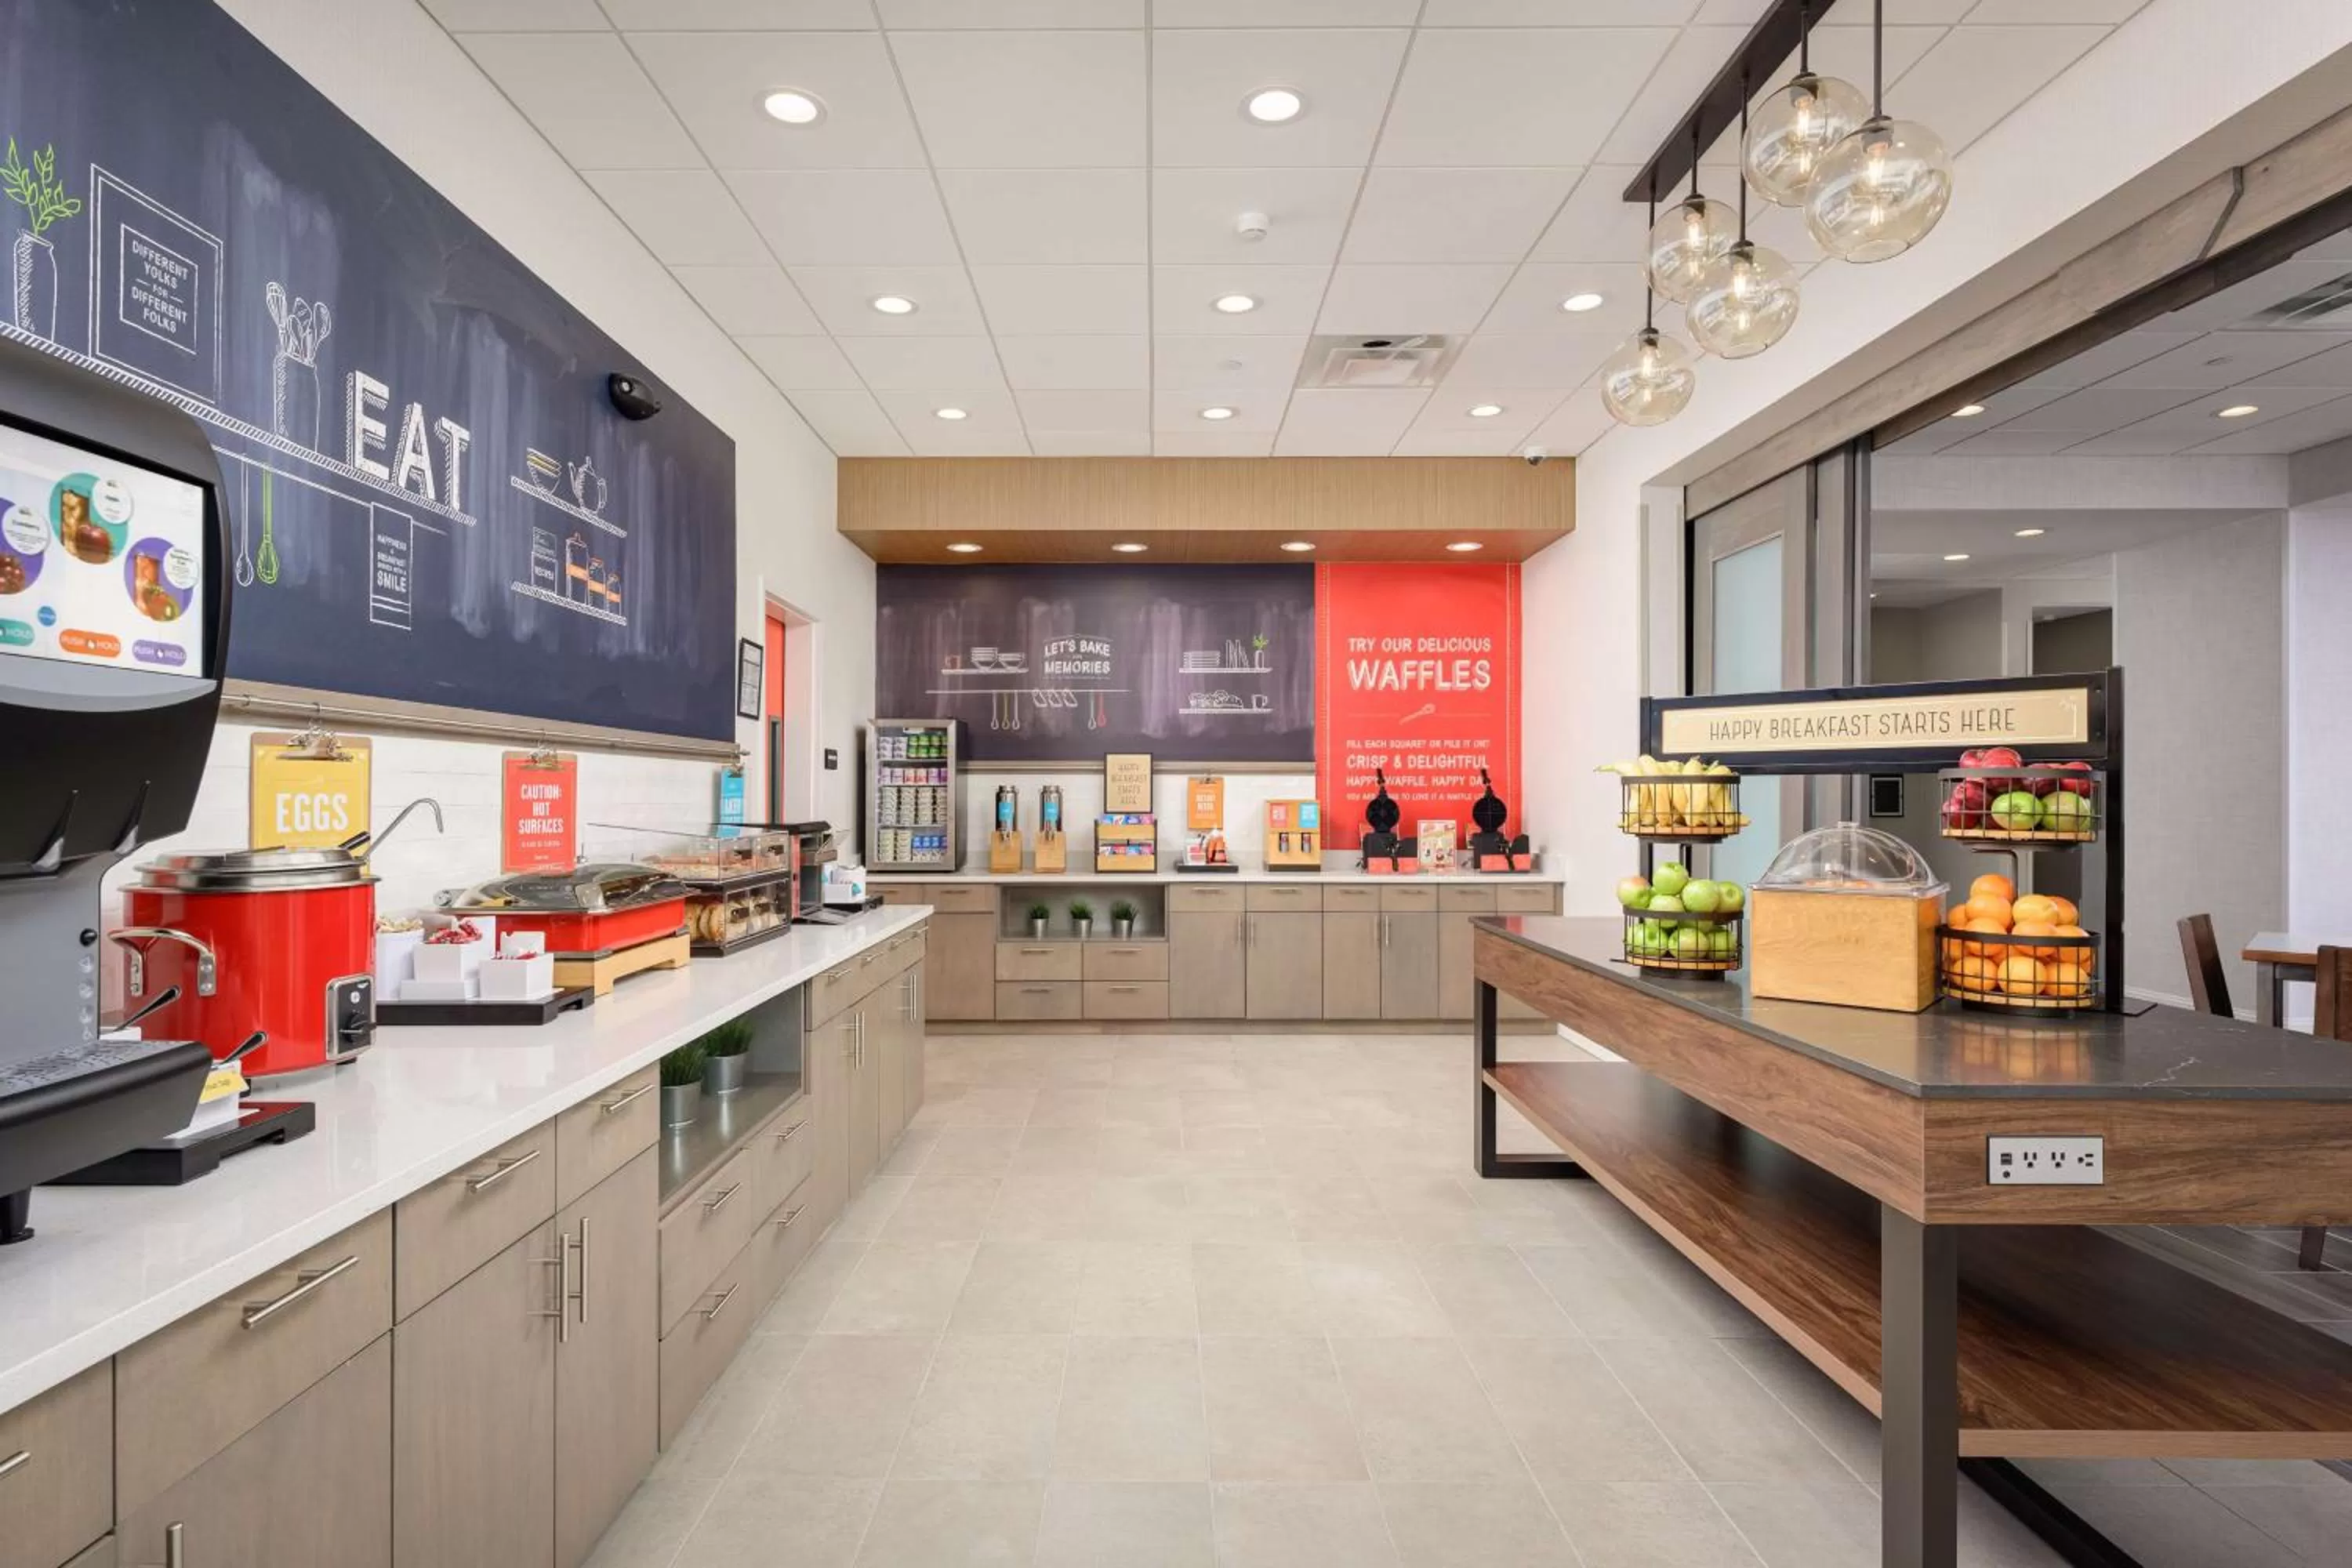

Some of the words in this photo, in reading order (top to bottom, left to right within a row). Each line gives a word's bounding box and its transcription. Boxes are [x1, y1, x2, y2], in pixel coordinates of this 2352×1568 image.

[132, 240, 188, 280] DIFFERENT
[144, 261, 178, 289] YOLKS
[132, 286, 187, 324] DIFFERENT
[143, 307, 176, 333] FOLKS
[346, 370, 470, 511] EAT
[377, 570, 407, 593] SMILE
[1044, 639, 1076, 657] LET'S
[1080, 639, 1110, 657] BAKE
[1348, 637, 1375, 653] TRY
[1381, 637, 1412, 653] OUR
[1417, 637, 1491, 653] DELICIOUS
[1044, 661, 1111, 675] MEMORIES
[1347, 659, 1491, 691] WAFFLES
[1709, 718, 1763, 741] HAPPY
[1769, 714, 1871, 739] BREAKFAST
[1878, 710, 1951, 735] STARTS
[1961, 708, 2016, 732] HERE
[1365, 739, 1387, 749] EACH
[1346, 754, 1388, 770] CRISP
[1393, 754, 1403, 770] &
[1407, 754, 1490, 770] DELIGHTFUL
[1432, 775, 1465, 786] HAPPY
[521, 783, 562, 800] CAUTION:
[276, 793, 349, 833] EGGS
[532, 801, 551, 816] HOT
[519, 818, 564, 834] SURFACES
